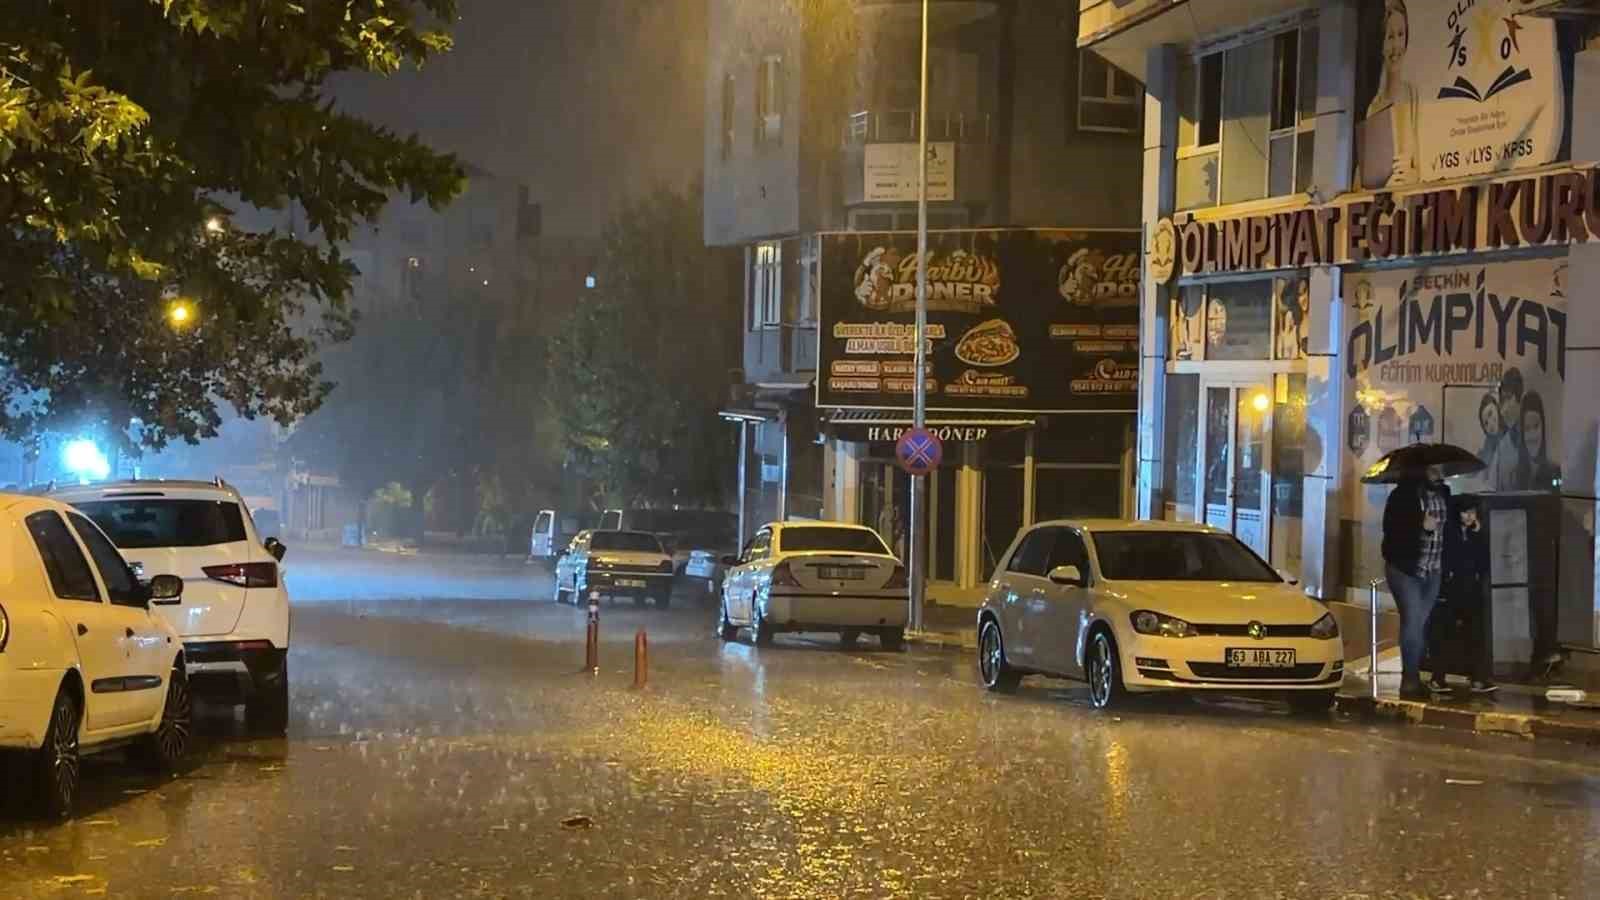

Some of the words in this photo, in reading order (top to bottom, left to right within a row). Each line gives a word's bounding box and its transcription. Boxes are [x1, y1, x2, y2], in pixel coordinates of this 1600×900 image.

[1439, 151, 1460, 169] YGS
[1473, 145, 1493, 163] LYS
[1503, 138, 1533, 160] KPSS
[1347, 187, 1477, 260] EĞİTİM
[897, 250, 980, 281] Harbi
[1413, 268, 1471, 290] SEÇKİN
[1347, 267, 1567, 384] OLİMPİYAT
[1425, 362, 1504, 384] KURUMLARI
[868, 427, 911, 441] HAR
[1232, 651, 1246, 662] 63
[1253, 651, 1271, 664] ABA
[1275, 652, 1294, 664] 227
